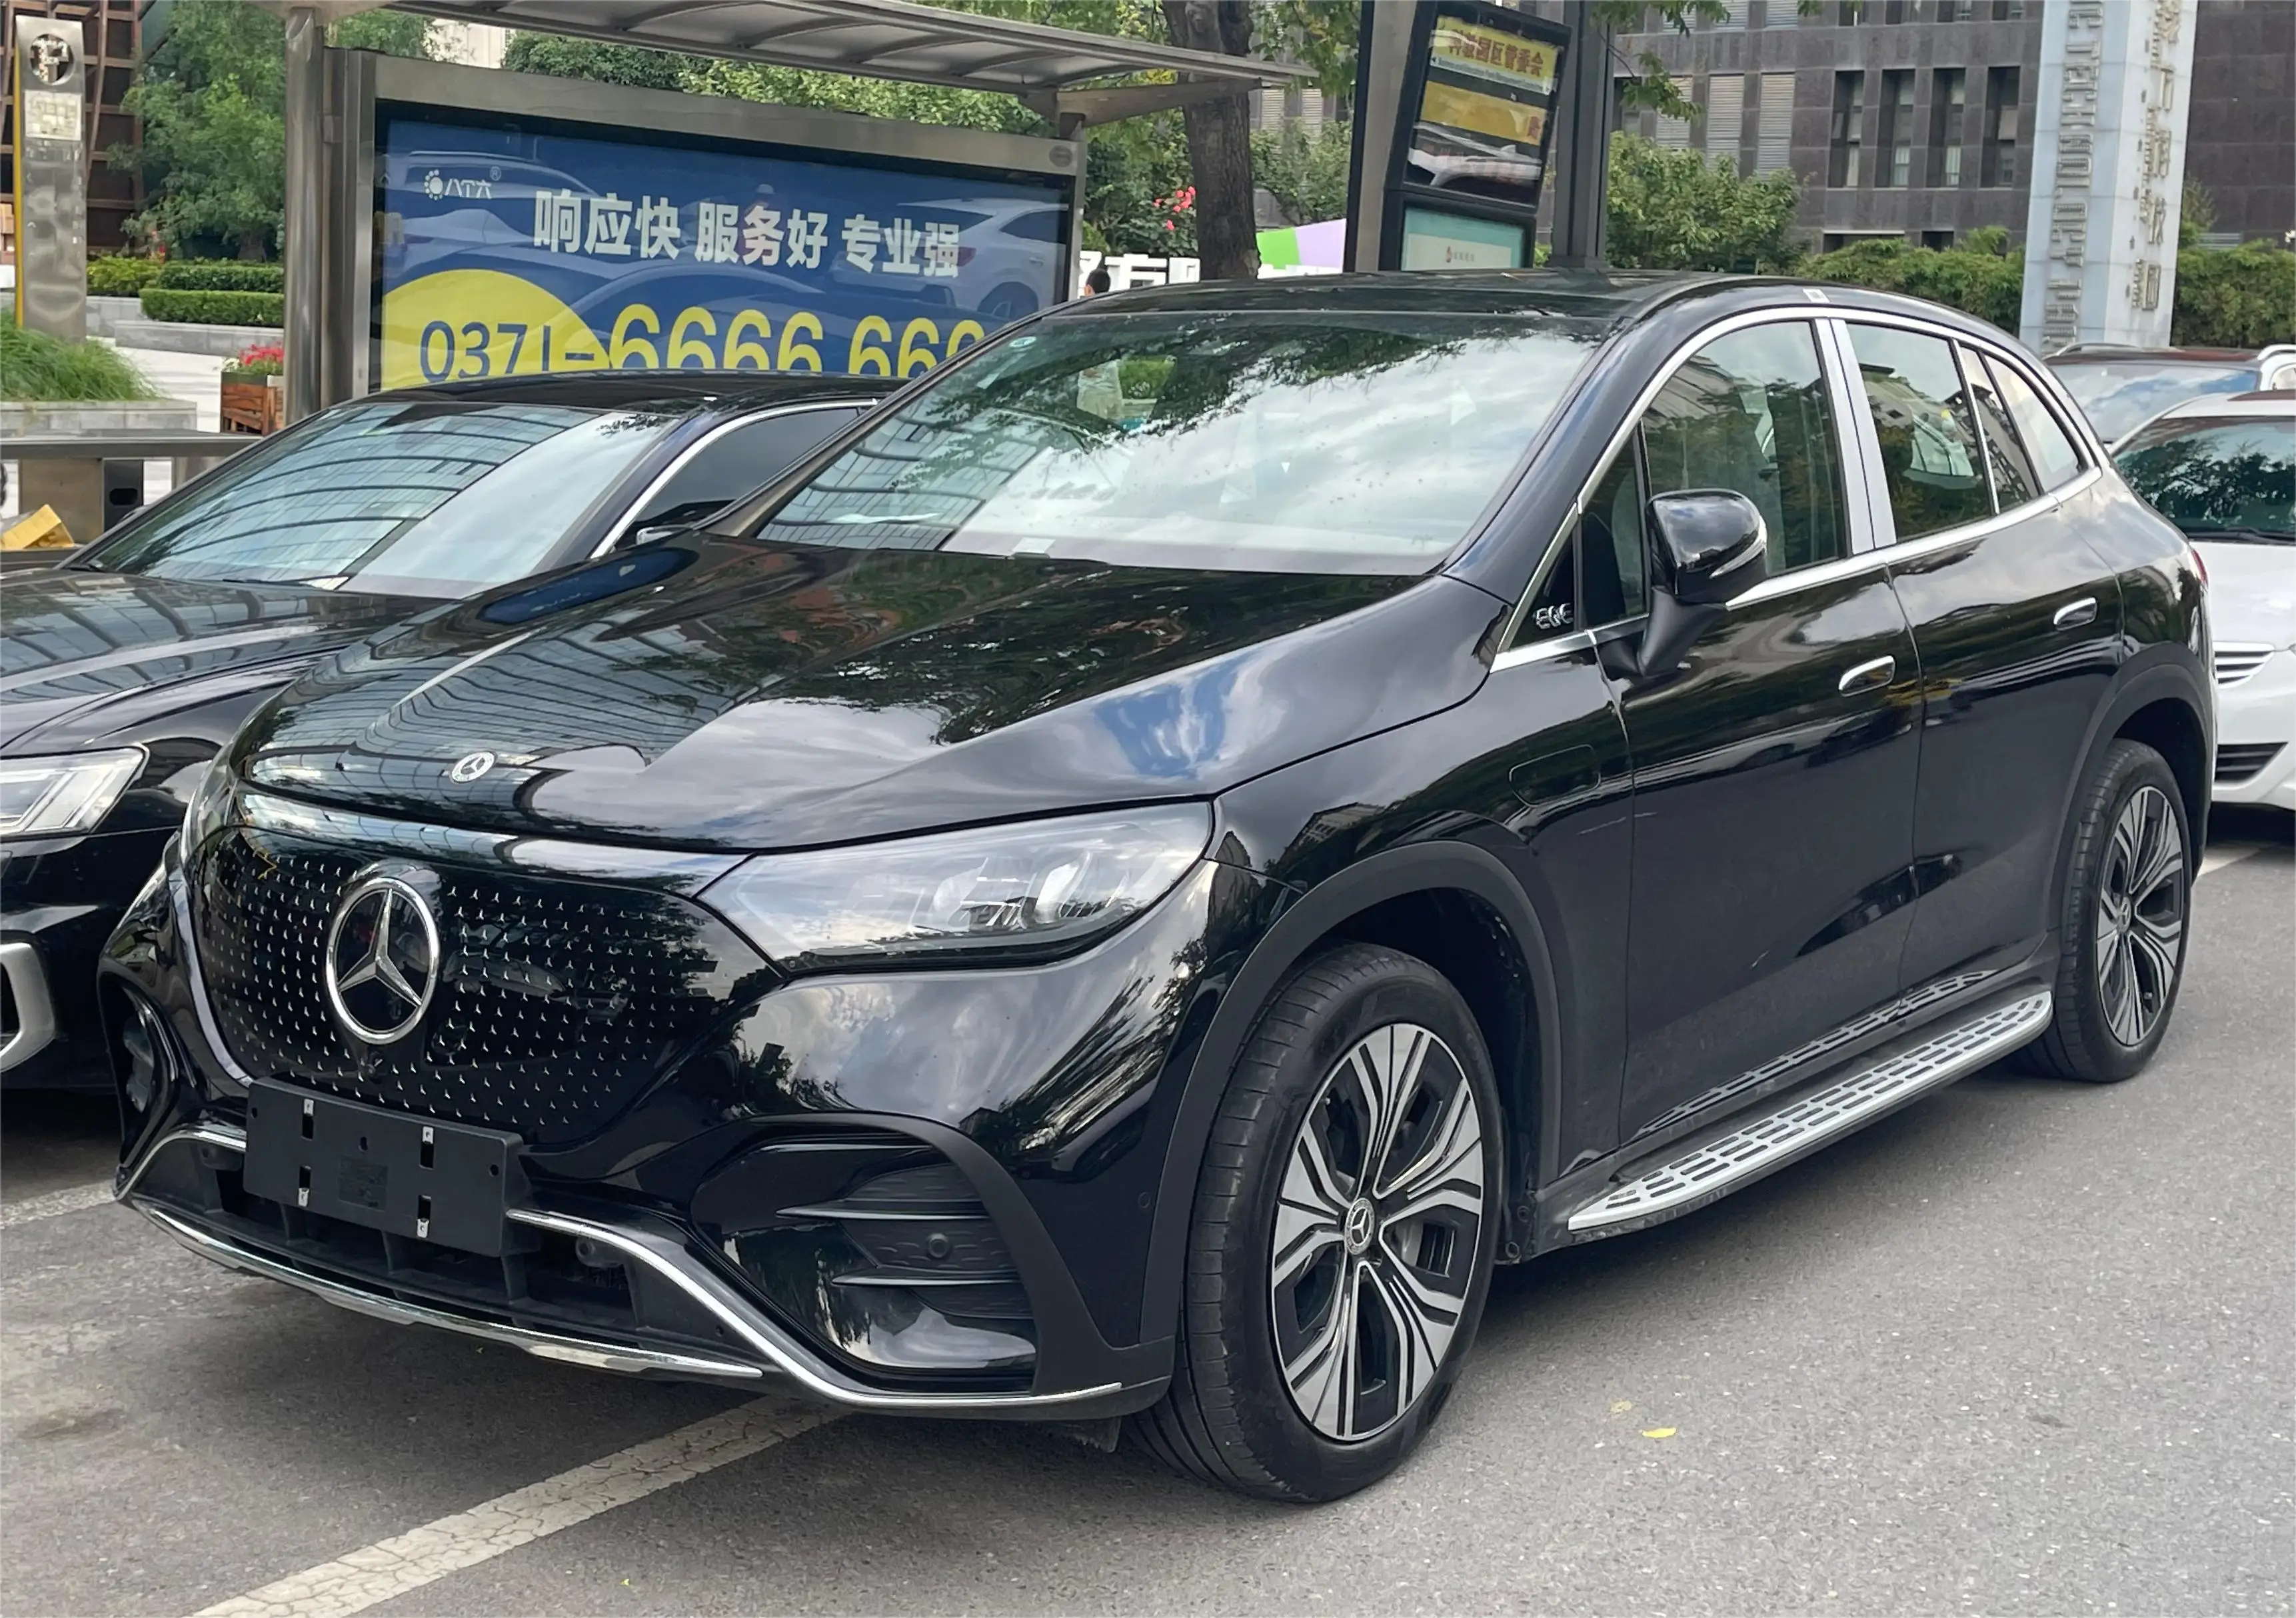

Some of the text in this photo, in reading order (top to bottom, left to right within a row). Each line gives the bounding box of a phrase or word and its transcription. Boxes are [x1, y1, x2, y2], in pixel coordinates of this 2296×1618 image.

[2049, 40, 2099, 267] TECHNOLOGY
[534, 189, 960, 277] 响应快 服务好 专业强
[2041, 279, 2081, 353] PAR
